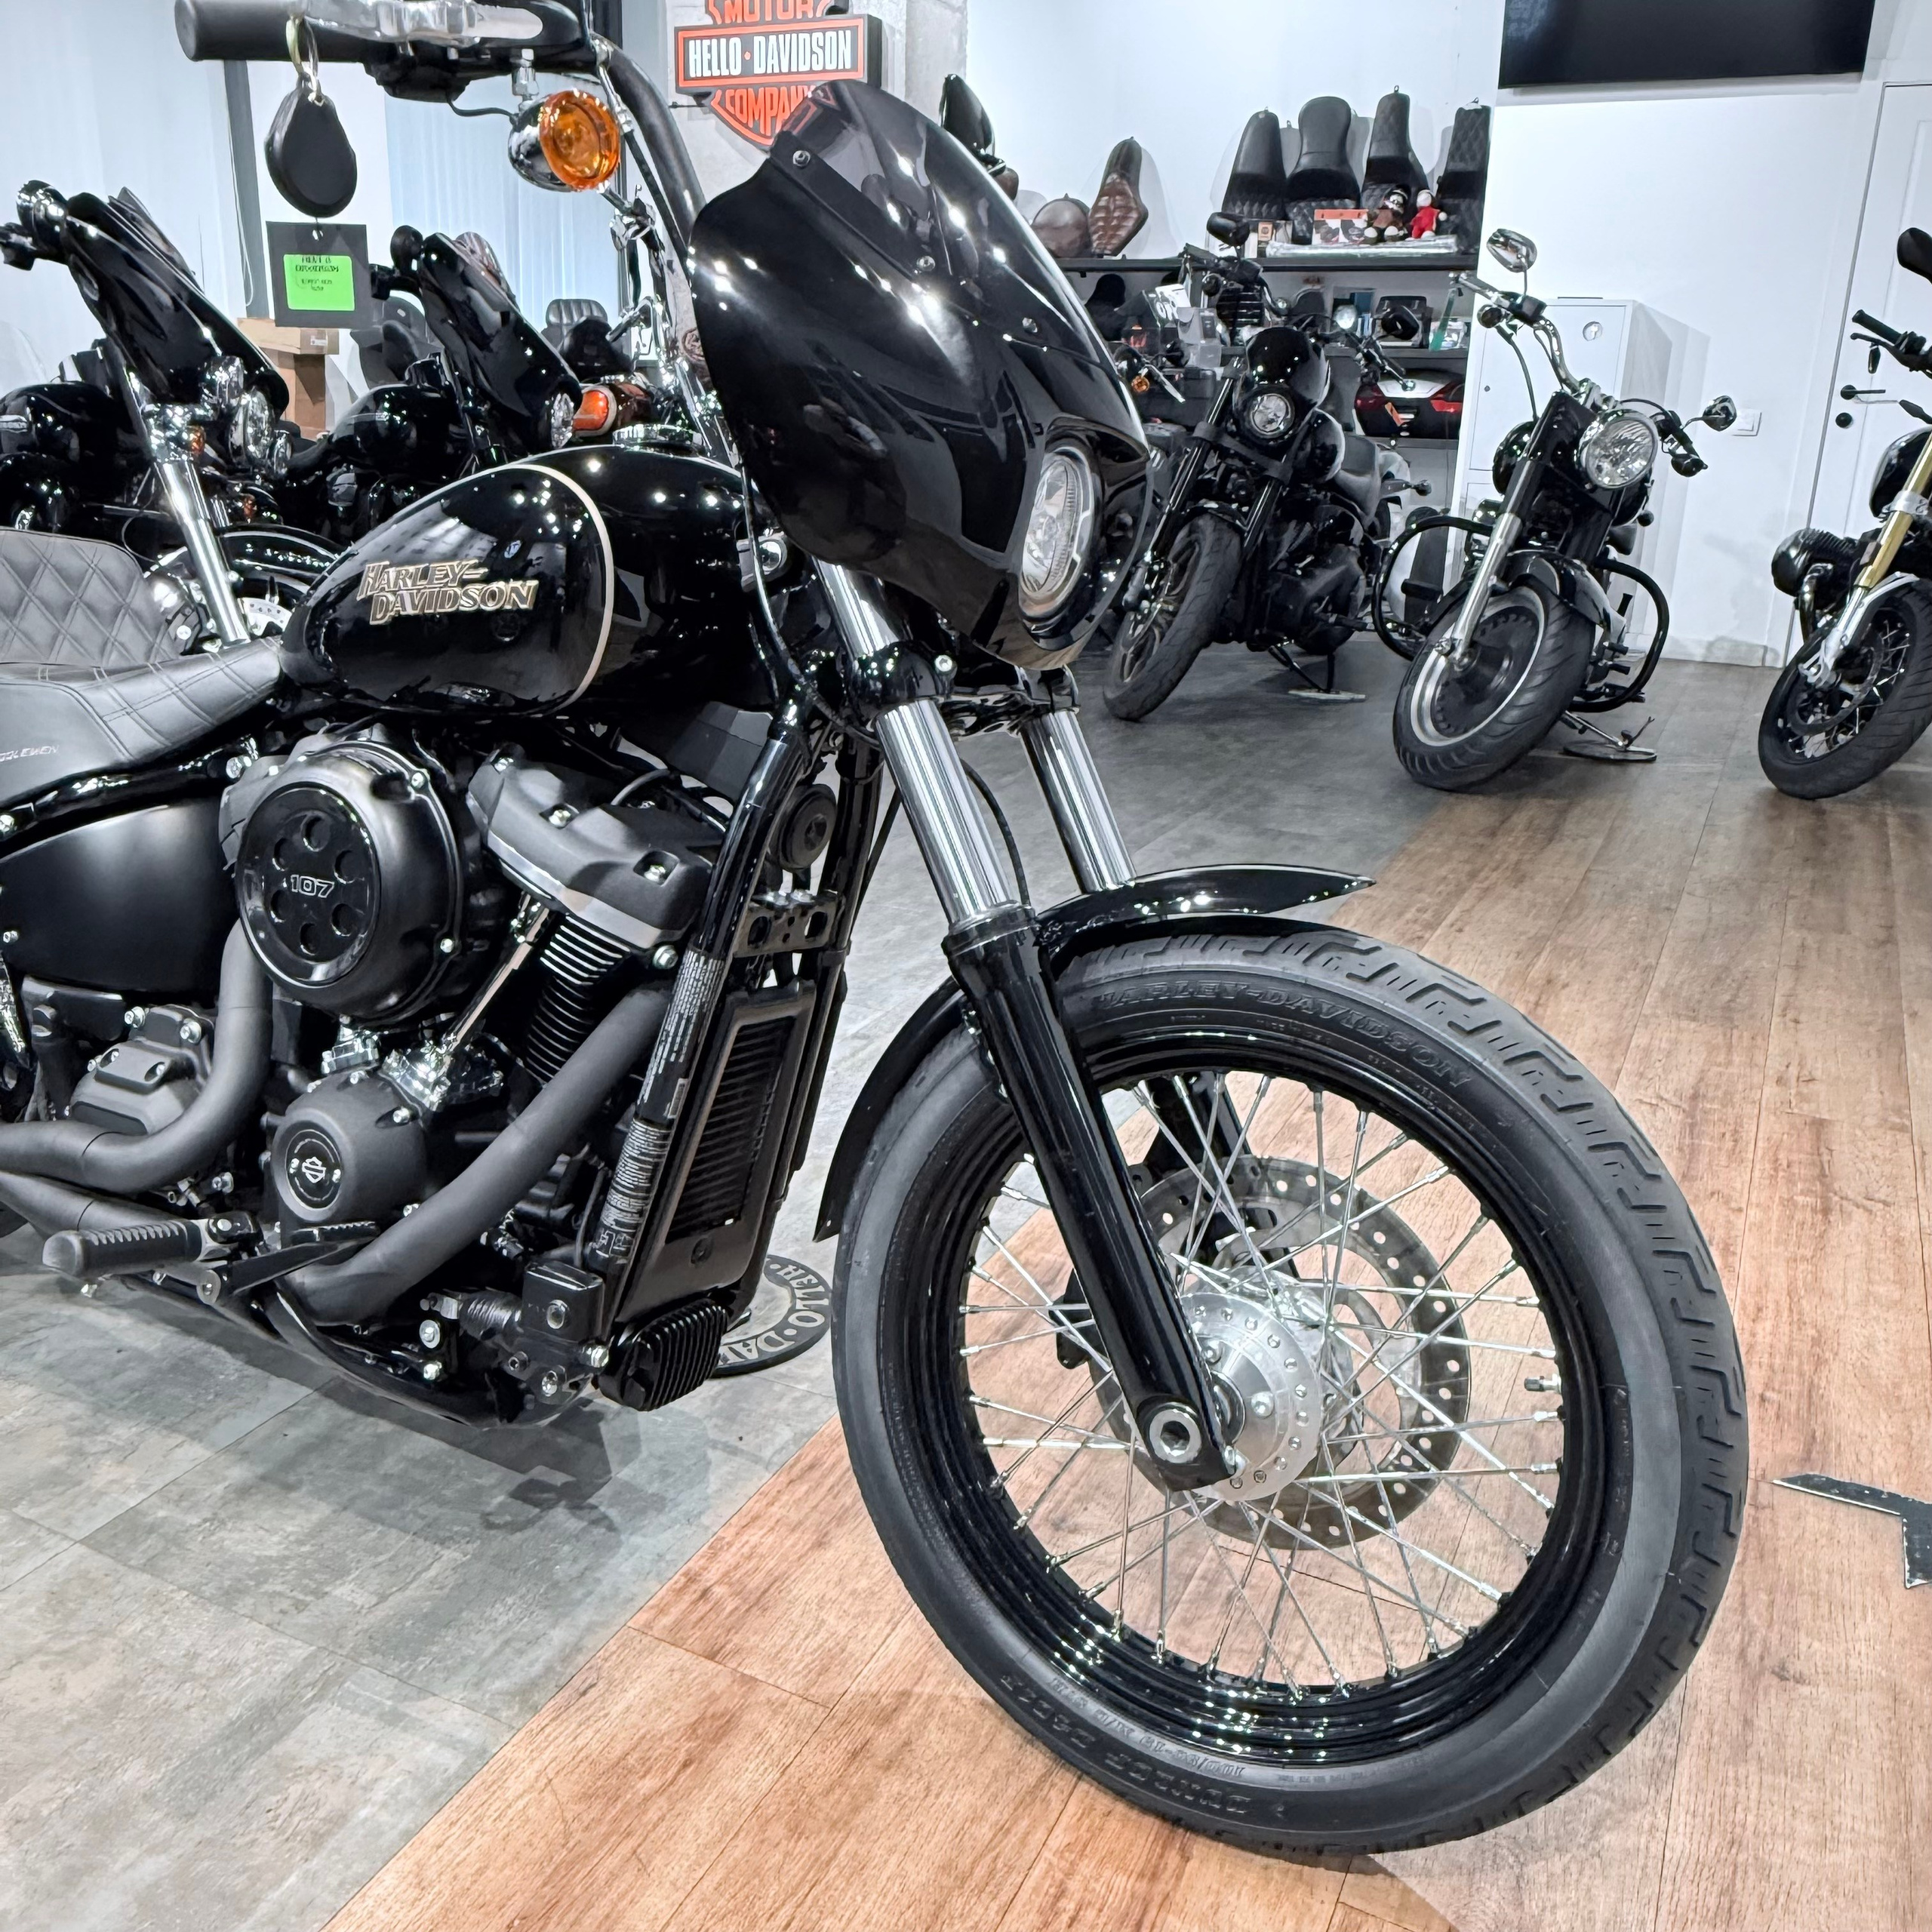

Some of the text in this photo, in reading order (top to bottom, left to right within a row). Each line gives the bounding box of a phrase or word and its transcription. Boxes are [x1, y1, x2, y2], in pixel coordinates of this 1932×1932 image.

[688, 29, 851, 78] HELLO DAVIDSON
[725, 85, 817, 137] COMPAN
[369, 580, 540, 626] DAVIDSON
[291, 874, 335, 898] 107
[776, 1264, 829, 1328] HELLO
